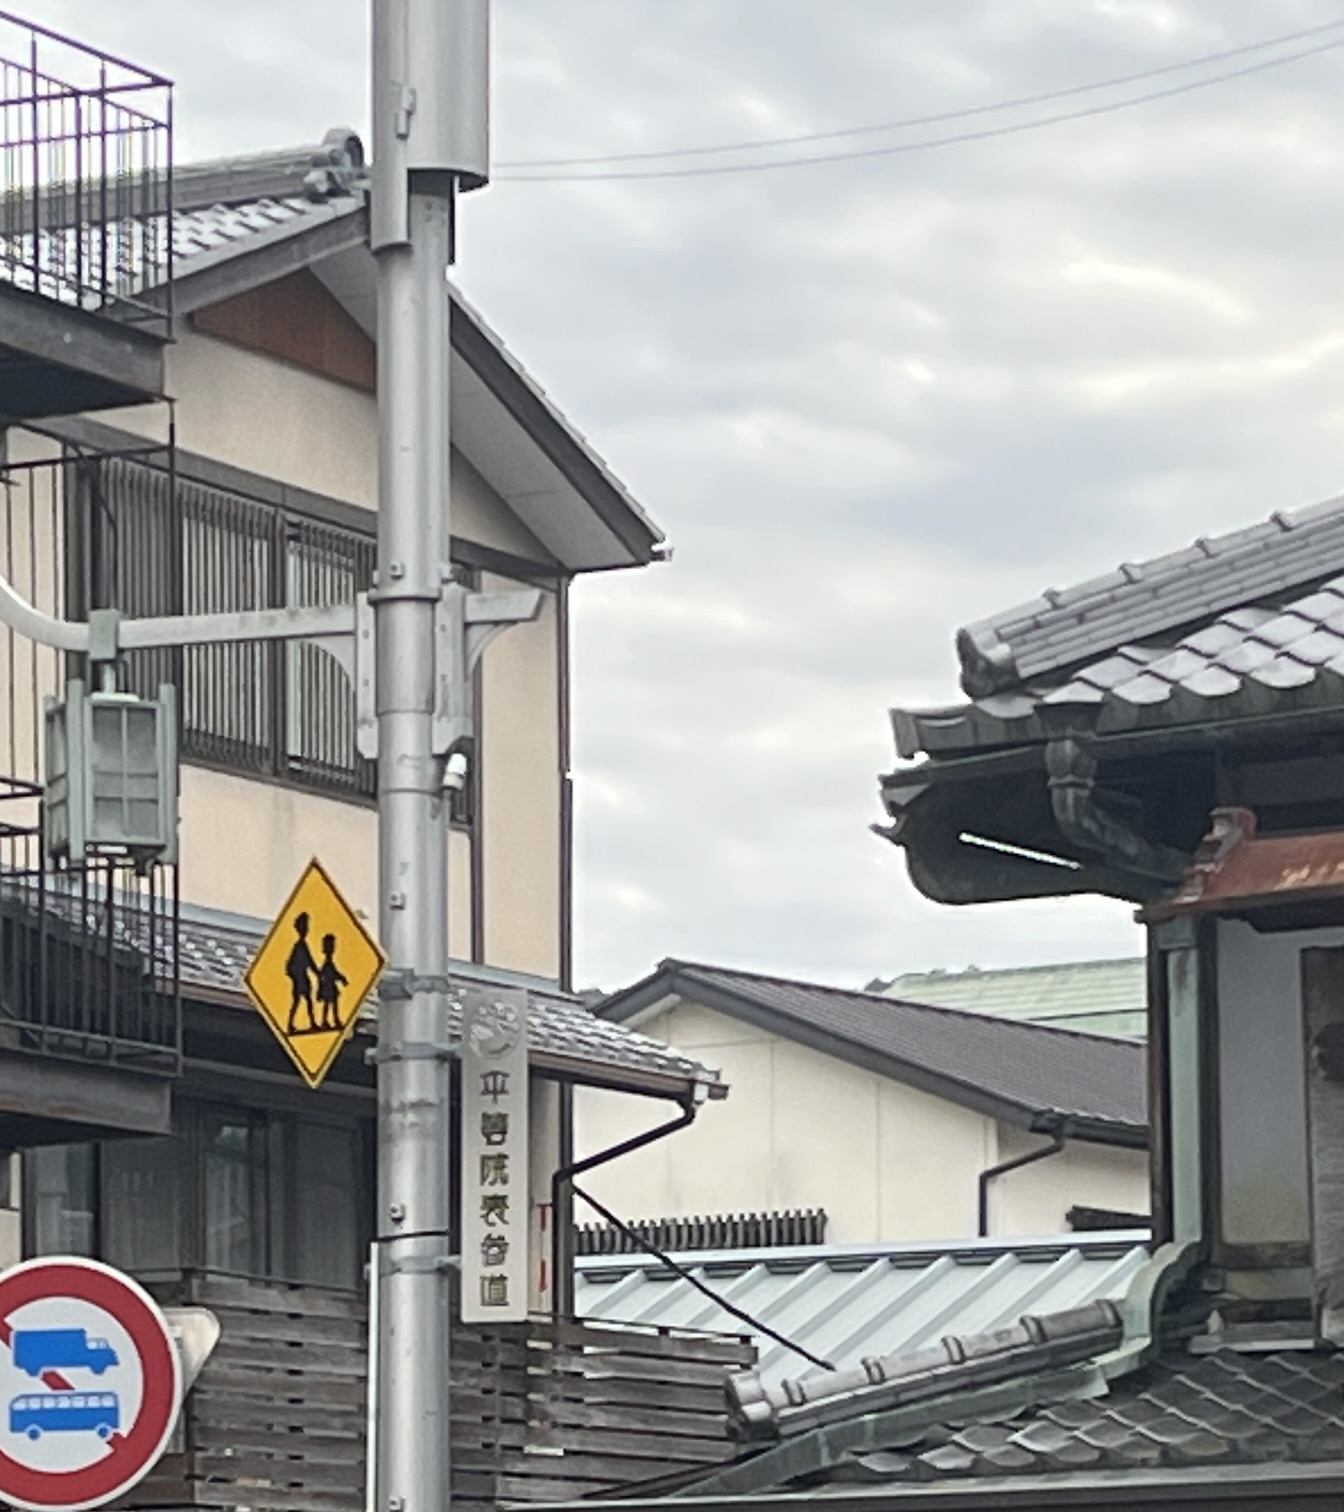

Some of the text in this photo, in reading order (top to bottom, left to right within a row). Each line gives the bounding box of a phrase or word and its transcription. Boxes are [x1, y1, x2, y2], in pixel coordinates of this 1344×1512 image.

[478, 1069, 511, 1308] 平等院表参道
